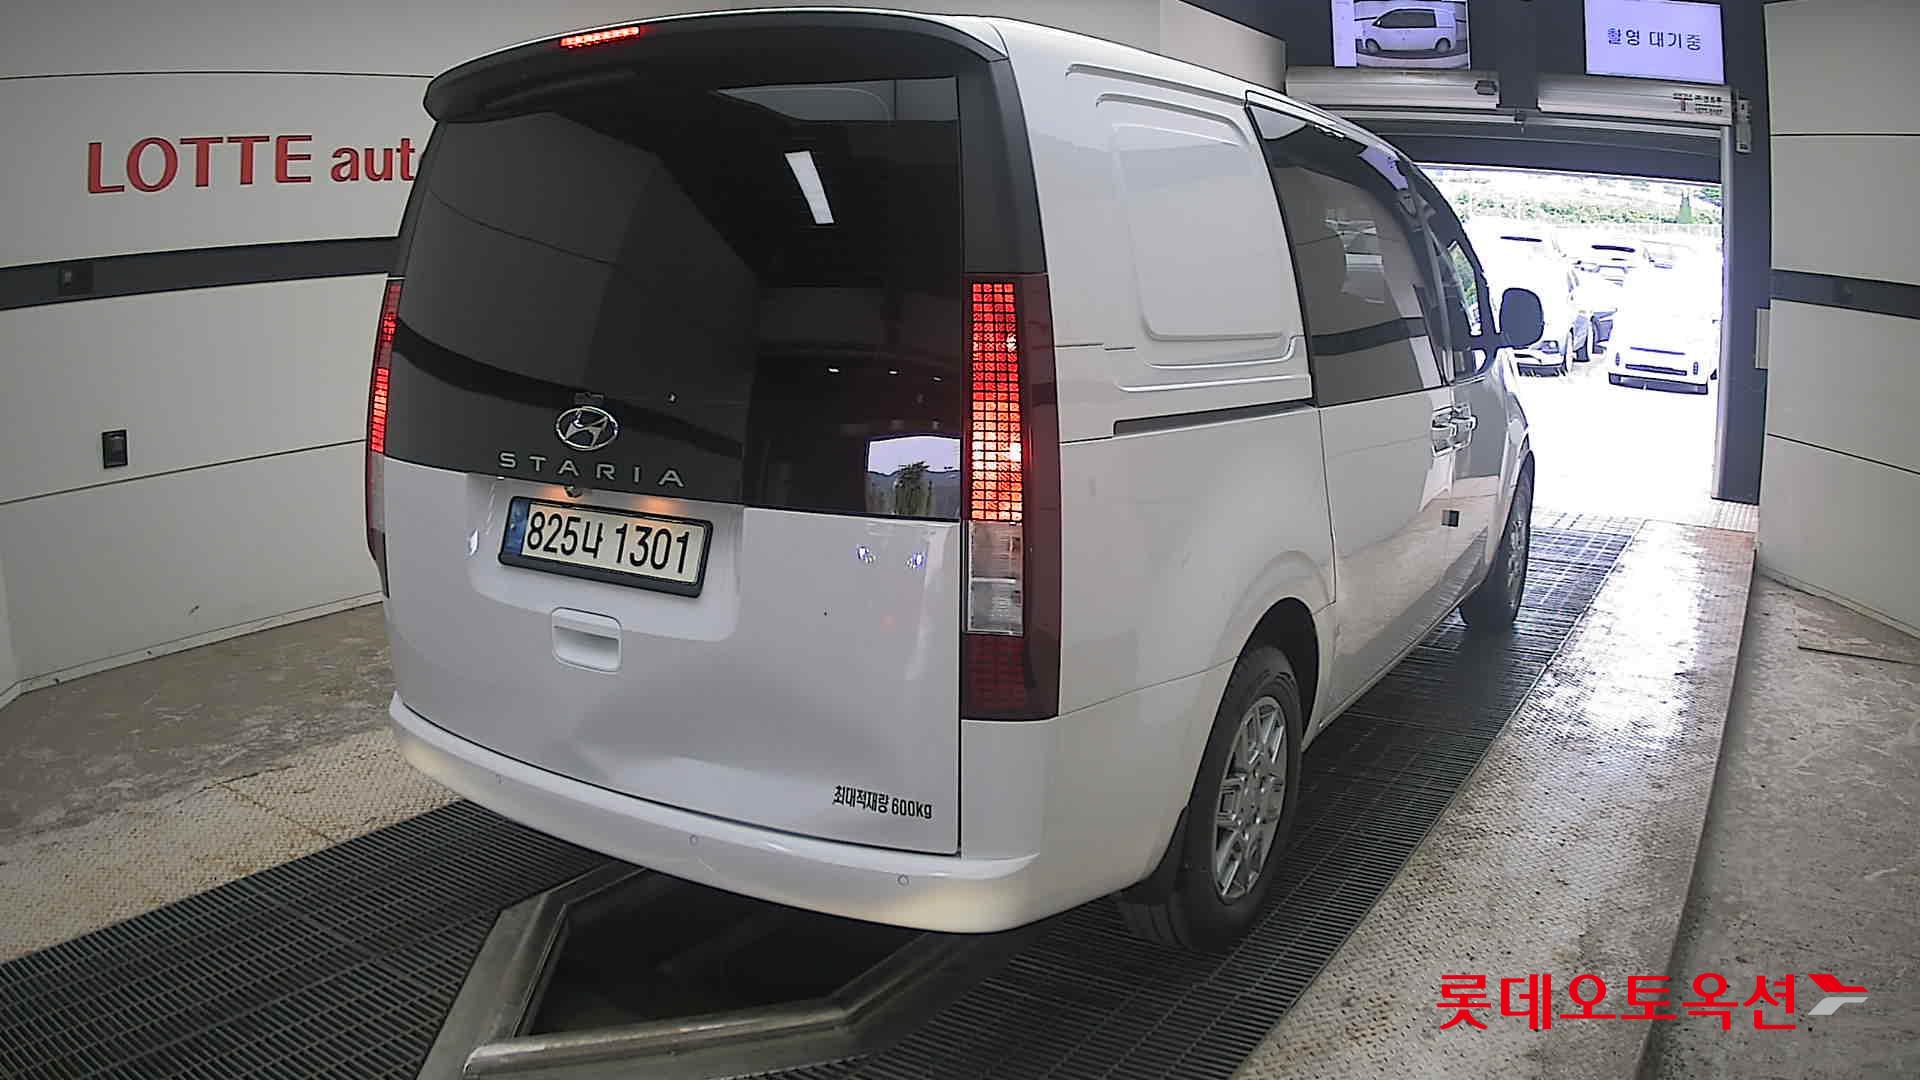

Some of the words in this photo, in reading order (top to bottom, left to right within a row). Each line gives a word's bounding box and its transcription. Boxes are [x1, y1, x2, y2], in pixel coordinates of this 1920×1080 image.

[88, 135, 312, 194] LOTTE
[331, 137, 419, 182] aut
[500, 452, 684, 487] STARIA
[527, 511, 604, 559] 825나
[615, 522, 690, 574] 1301
[832, 784, 889, 813] 최대적재량
[891, 797, 932, 819] 600kg
